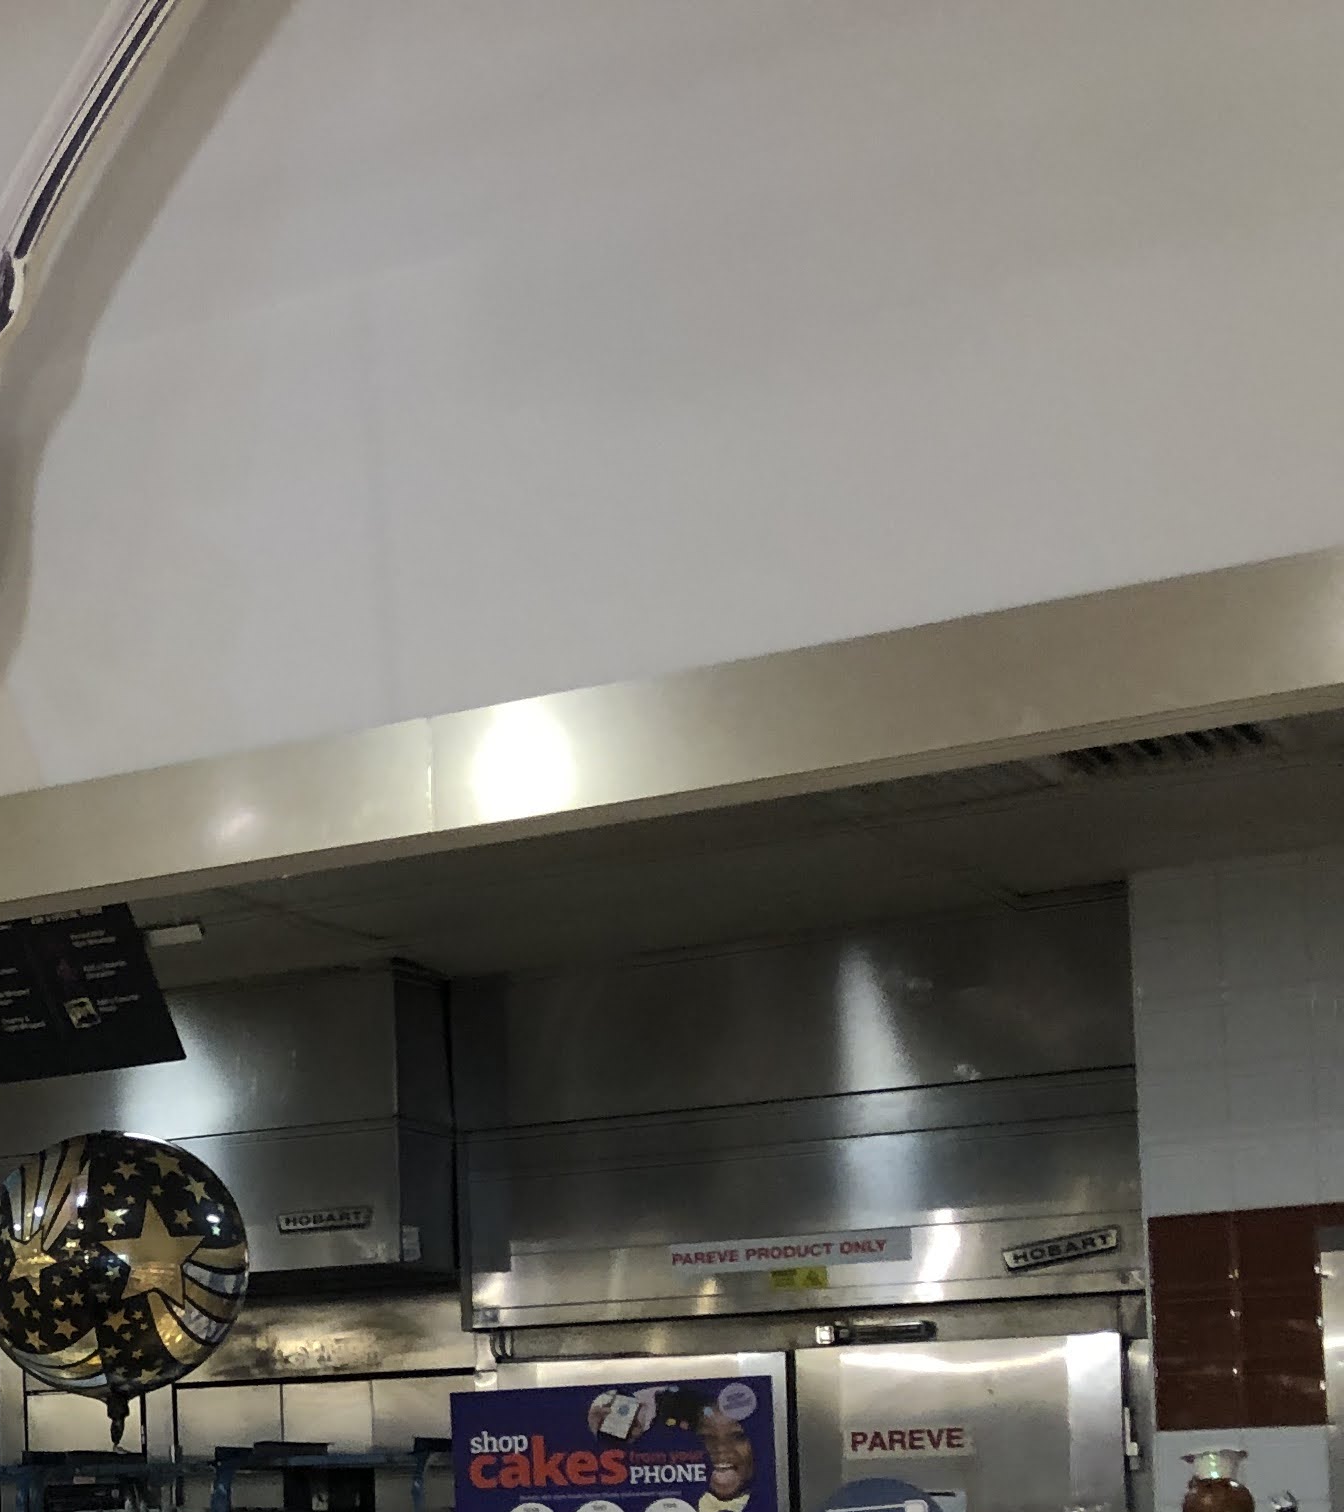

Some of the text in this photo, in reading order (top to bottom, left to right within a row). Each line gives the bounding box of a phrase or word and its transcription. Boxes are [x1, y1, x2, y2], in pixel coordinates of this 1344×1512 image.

[671, 1239, 887, 1266] PAREVE PRODUCT ONLY
[1012, 1233, 1111, 1266] HOBART
[470, 1431, 529, 1455] shop
[850, 1428, 964, 1452] PAREVE
[469, 1435, 629, 1489] cakes
[629, 1463, 707, 1485] PHONE
